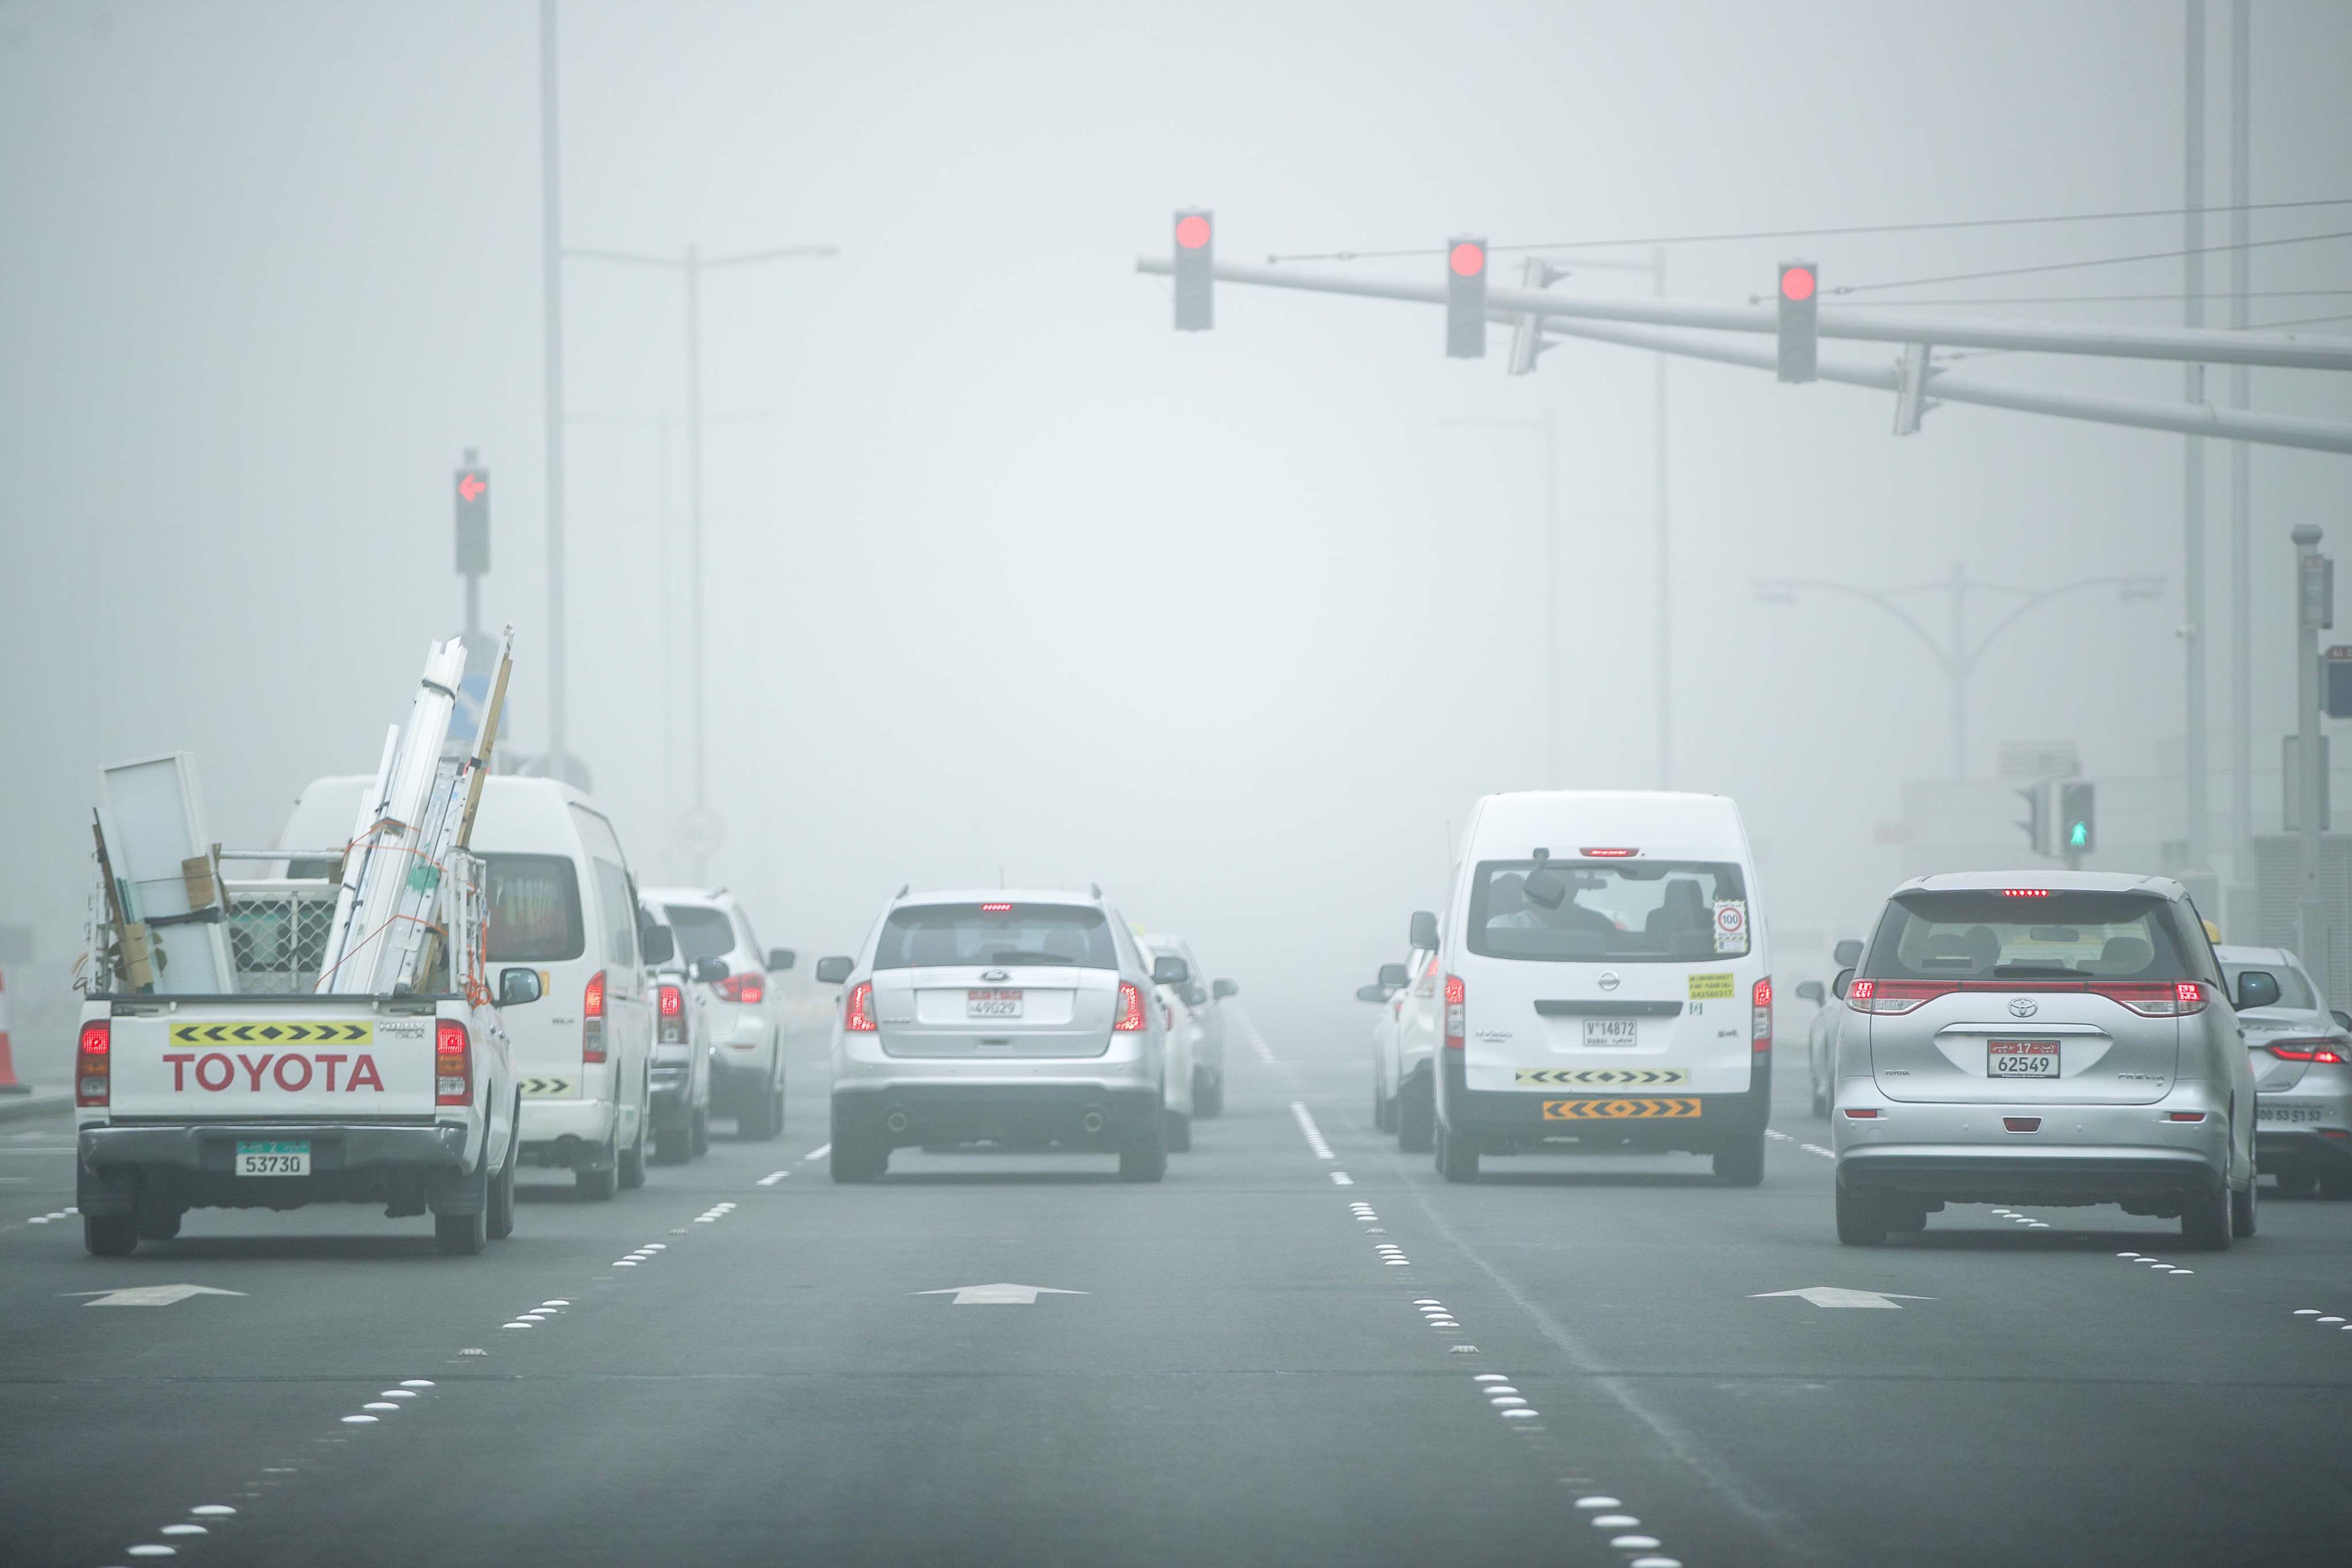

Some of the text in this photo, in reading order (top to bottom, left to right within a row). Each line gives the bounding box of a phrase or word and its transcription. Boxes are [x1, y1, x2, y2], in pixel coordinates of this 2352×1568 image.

[1722, 915, 1738, 924] 100
[1587, 1022, 1634, 1035] V 14872
[2017, 1043, 2031, 1053] 17
[1998, 1057, 2049, 1072] 62549
[162, 1052, 385, 1092] TOYOTA
[2118, 1073, 2164, 1081] PREVIA
[246, 1156, 300, 1173] 53730
